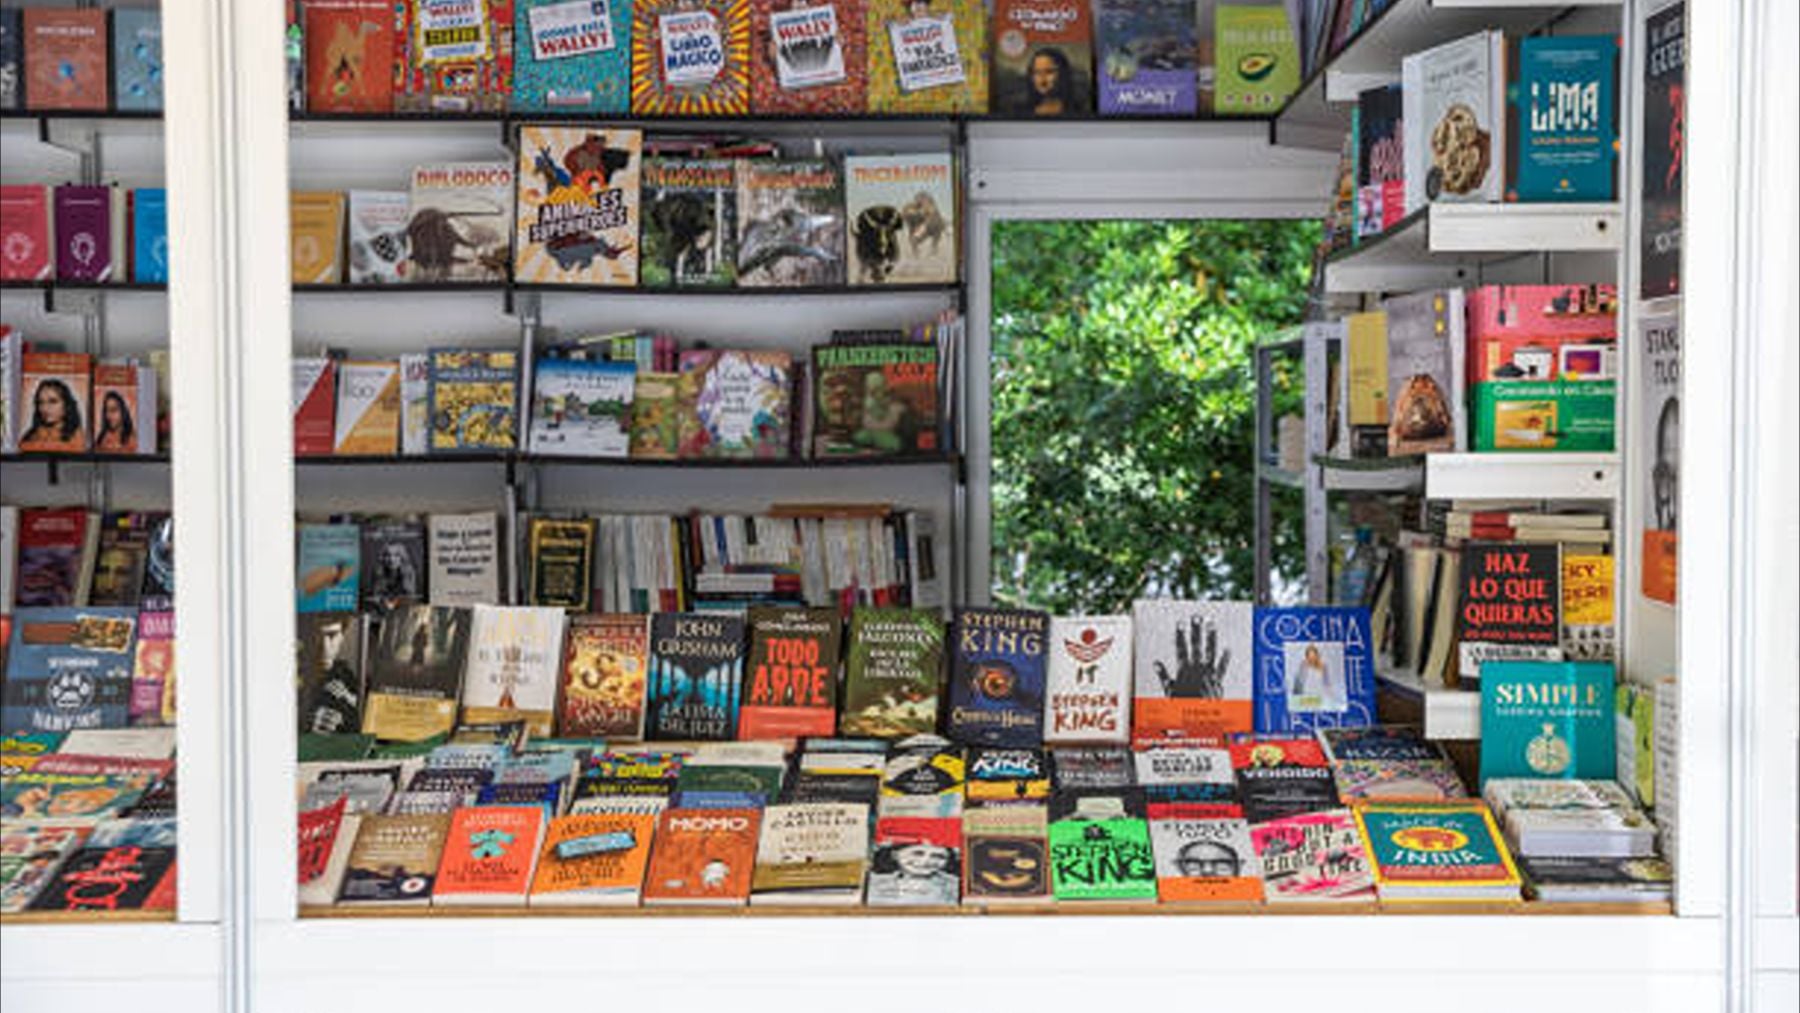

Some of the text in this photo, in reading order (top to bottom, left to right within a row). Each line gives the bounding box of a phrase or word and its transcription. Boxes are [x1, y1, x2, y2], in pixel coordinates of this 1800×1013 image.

[1532, 81, 1600, 132] LIMA
[416, 169, 512, 188] DIPLODOCO
[1485, 552, 1531, 573] HAZ
[1469, 578, 1499, 599] LO
[1504, 578, 1548, 600] QUE
[962, 612, 1044, 630] STEPHEN
[1463, 602, 1554, 625] QUIERAS
[674, 620, 723, 638] JOHN
[657, 640, 738, 658] GRISHAM
[766, 637, 820, 664] TODO
[960, 631, 1042, 655] KING
[751, 664, 830, 705] ARDE
[1076, 664, 1099, 684] IT
[1052, 693, 1119, 710] STEPHEN
[1496, 683, 1601, 705] SIMPLE
[1054, 711, 1117, 734] KING
[972, 758, 1040, 774] KING
[668, 816, 749, 831] MOMO
[1056, 856, 1153, 886] KING
